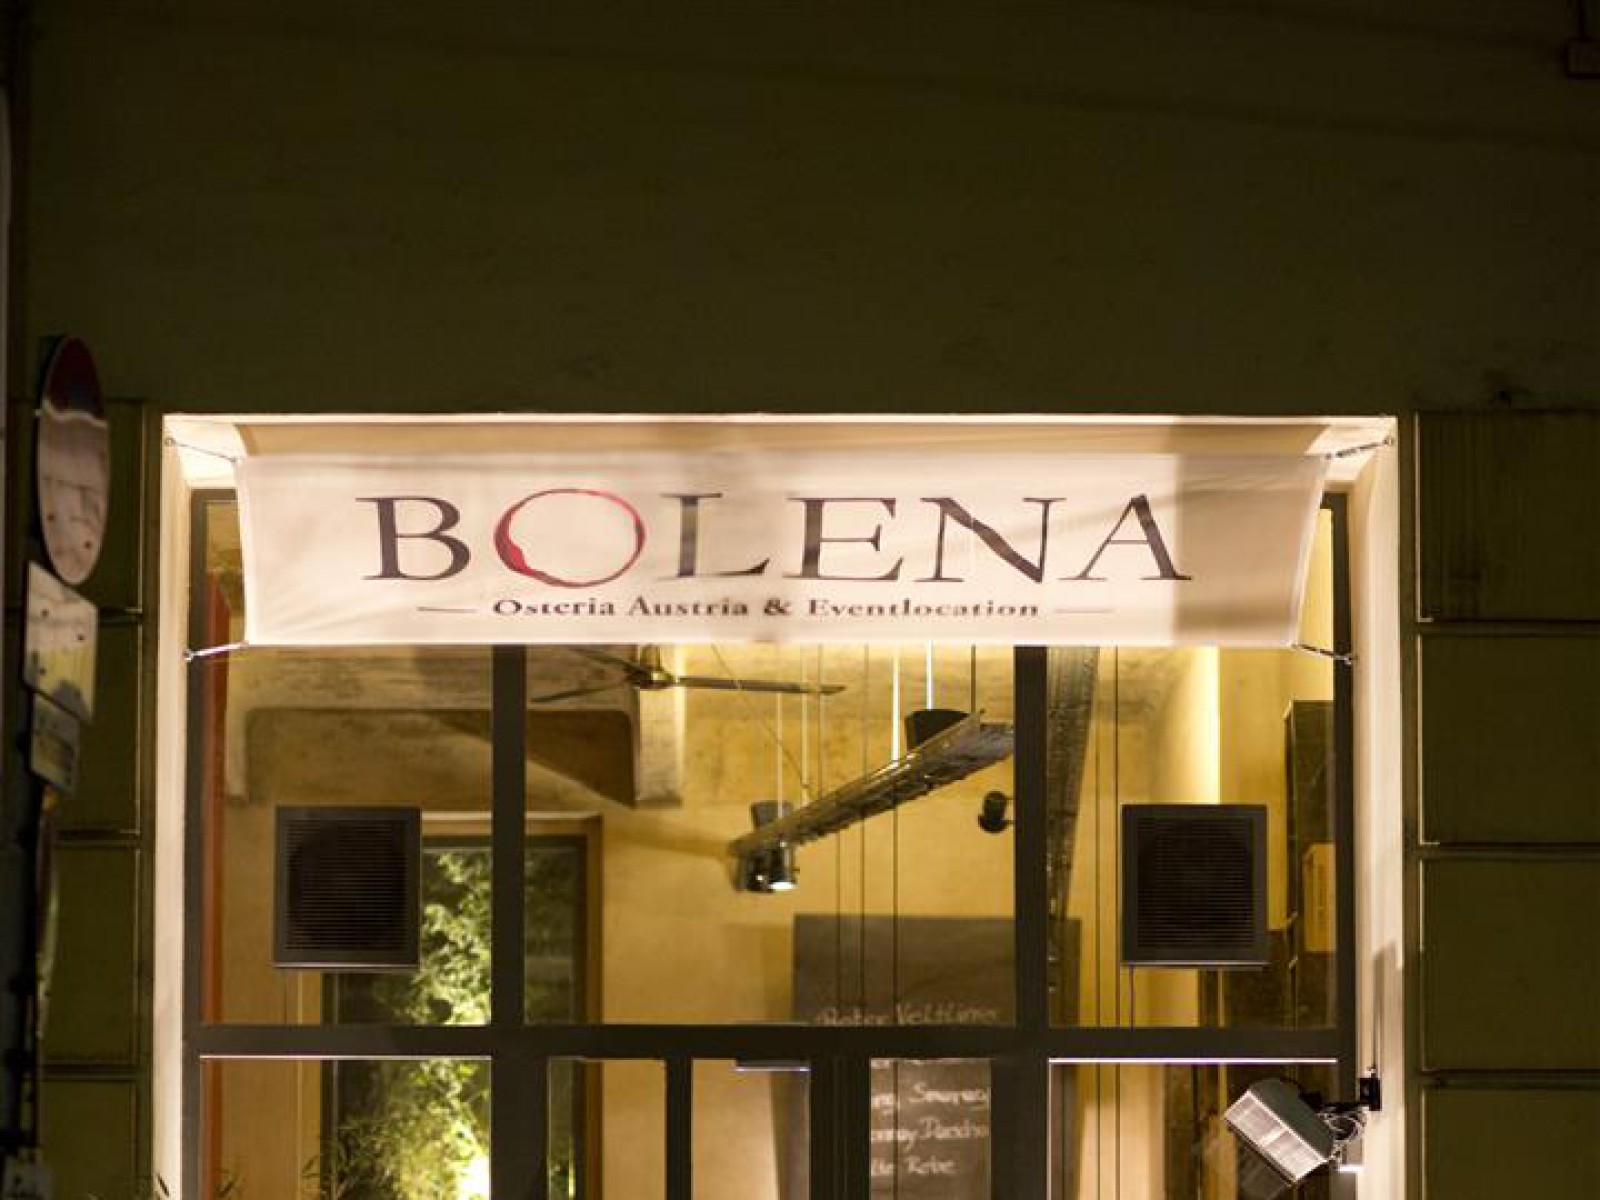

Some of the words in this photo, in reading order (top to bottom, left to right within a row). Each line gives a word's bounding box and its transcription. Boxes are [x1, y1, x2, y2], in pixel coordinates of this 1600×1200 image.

[355, 489, 1192, 588] BOLENA
[493, 597, 615, 616] Osteria
[629, 595, 748, 616] Austria
[763, 597, 793, 616] &
[808, 598, 1038, 616] Eventlocation
